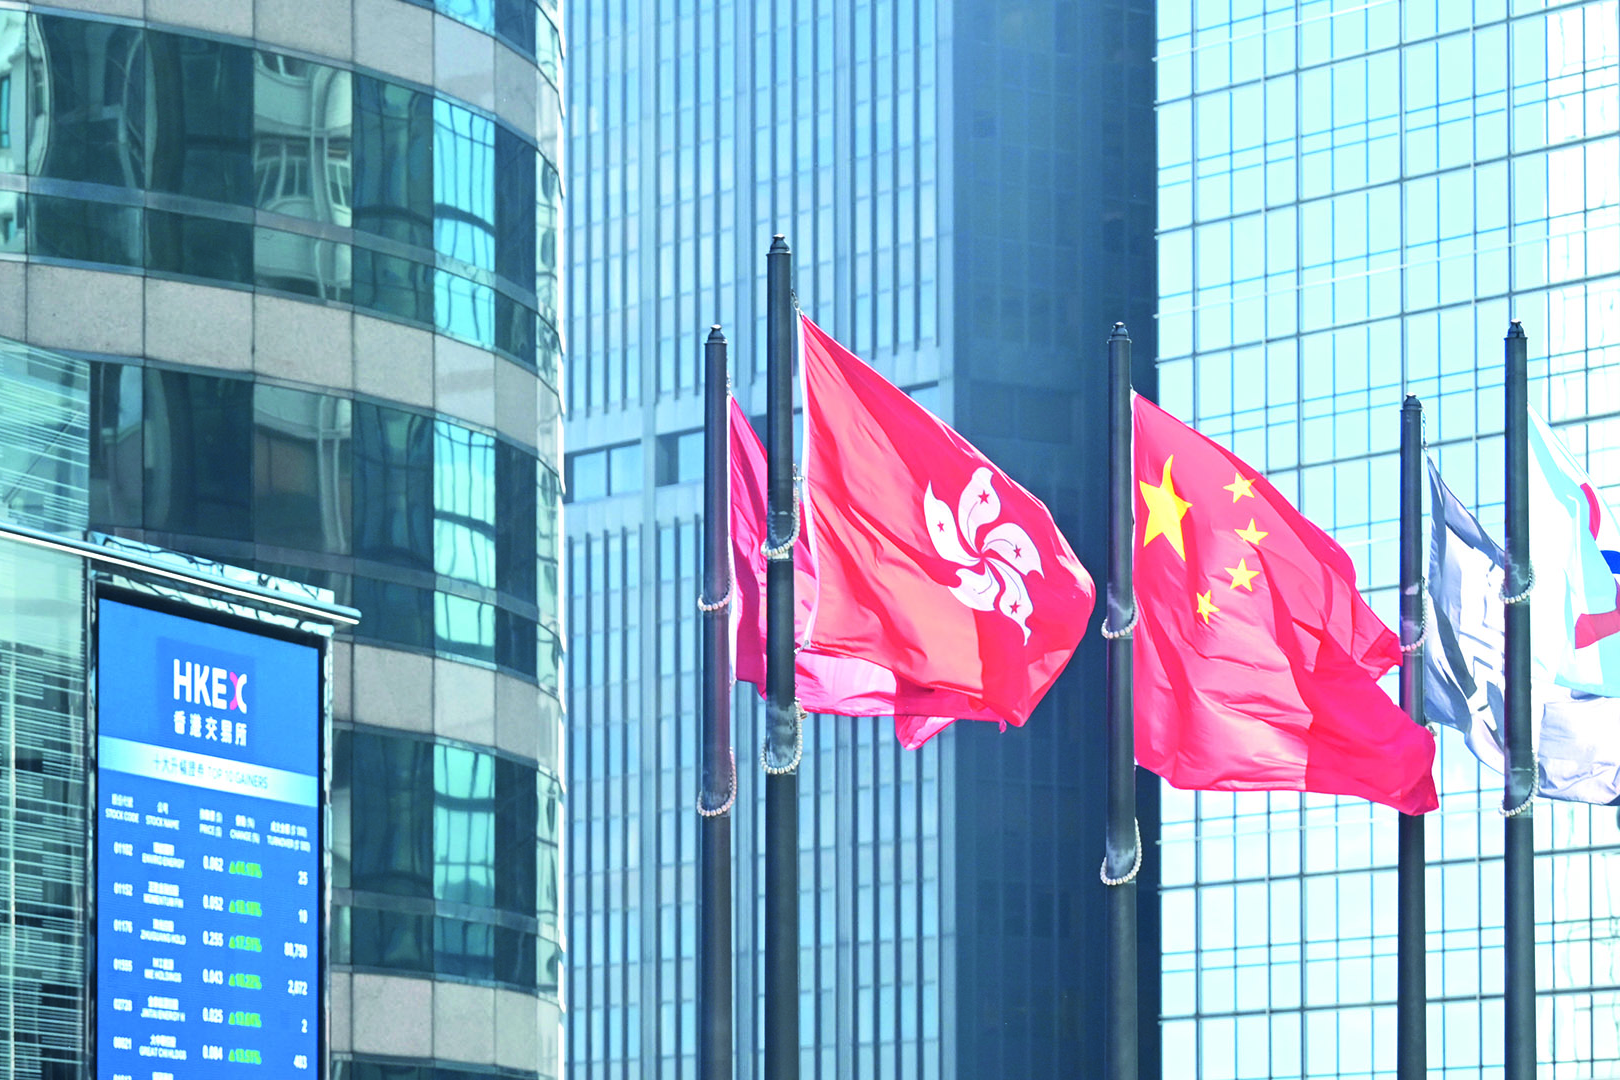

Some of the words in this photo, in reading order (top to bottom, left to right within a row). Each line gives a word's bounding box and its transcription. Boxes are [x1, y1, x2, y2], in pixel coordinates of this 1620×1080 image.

[173, 658, 248, 714] HKEX
[174, 711, 247, 747] 香港交易所
[235, 771, 269, 790] GAINERS
[298, 870, 308, 886] 25
[301, 1018, 308, 1034] 2
